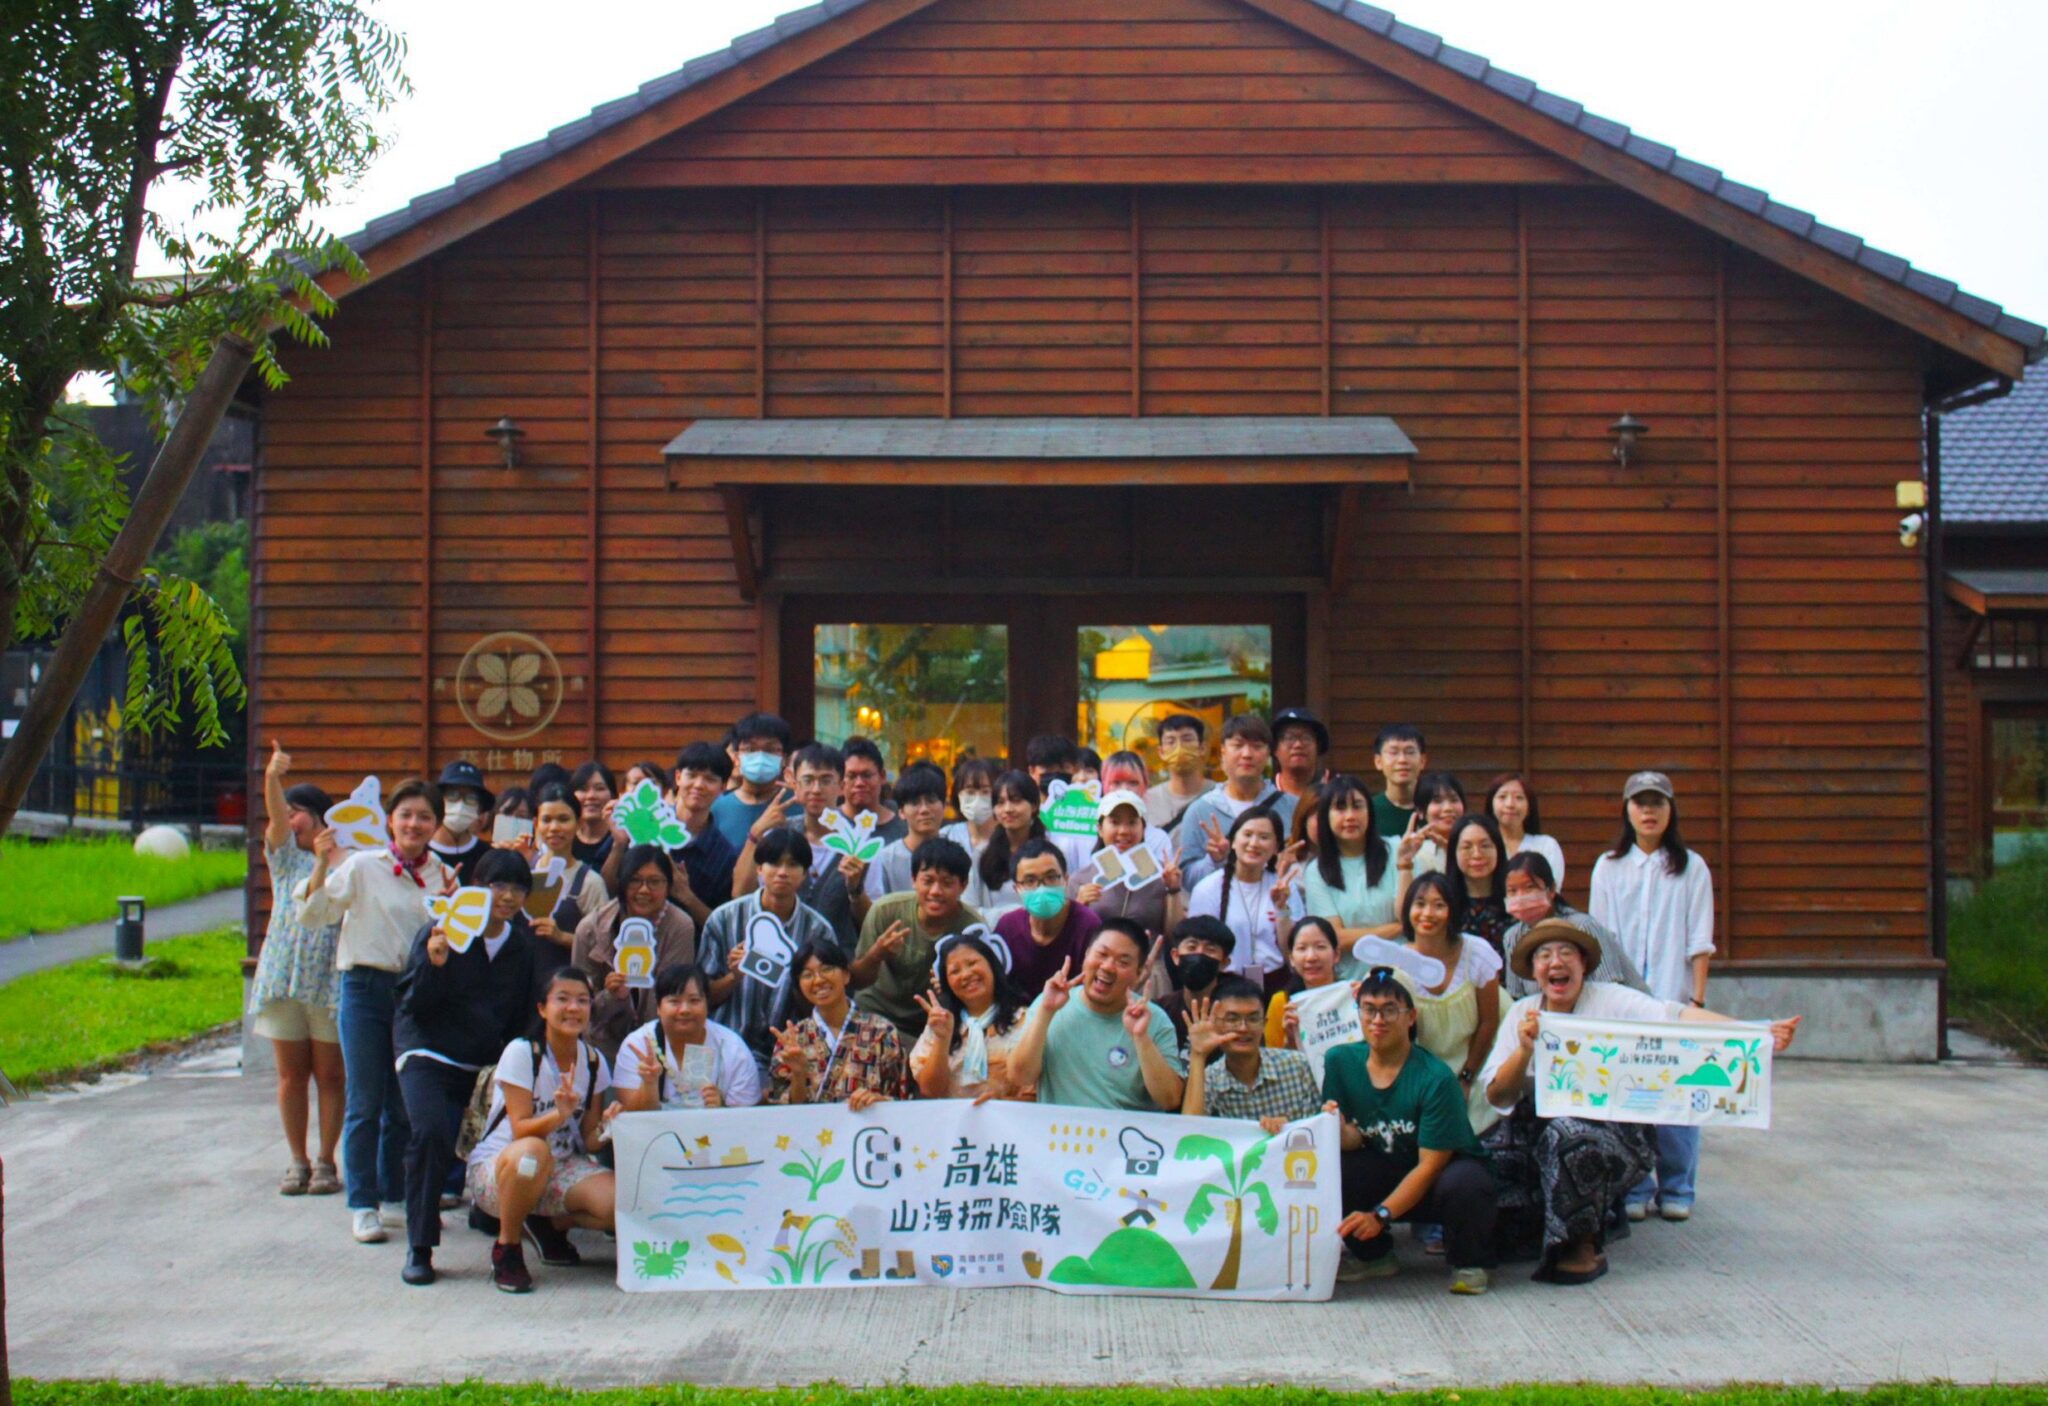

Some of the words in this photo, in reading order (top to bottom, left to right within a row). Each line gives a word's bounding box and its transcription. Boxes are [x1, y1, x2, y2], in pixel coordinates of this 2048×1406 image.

[943, 1137, 1019, 1188] 高雄
[889, 1197, 1062, 1236] 山海探險隊
